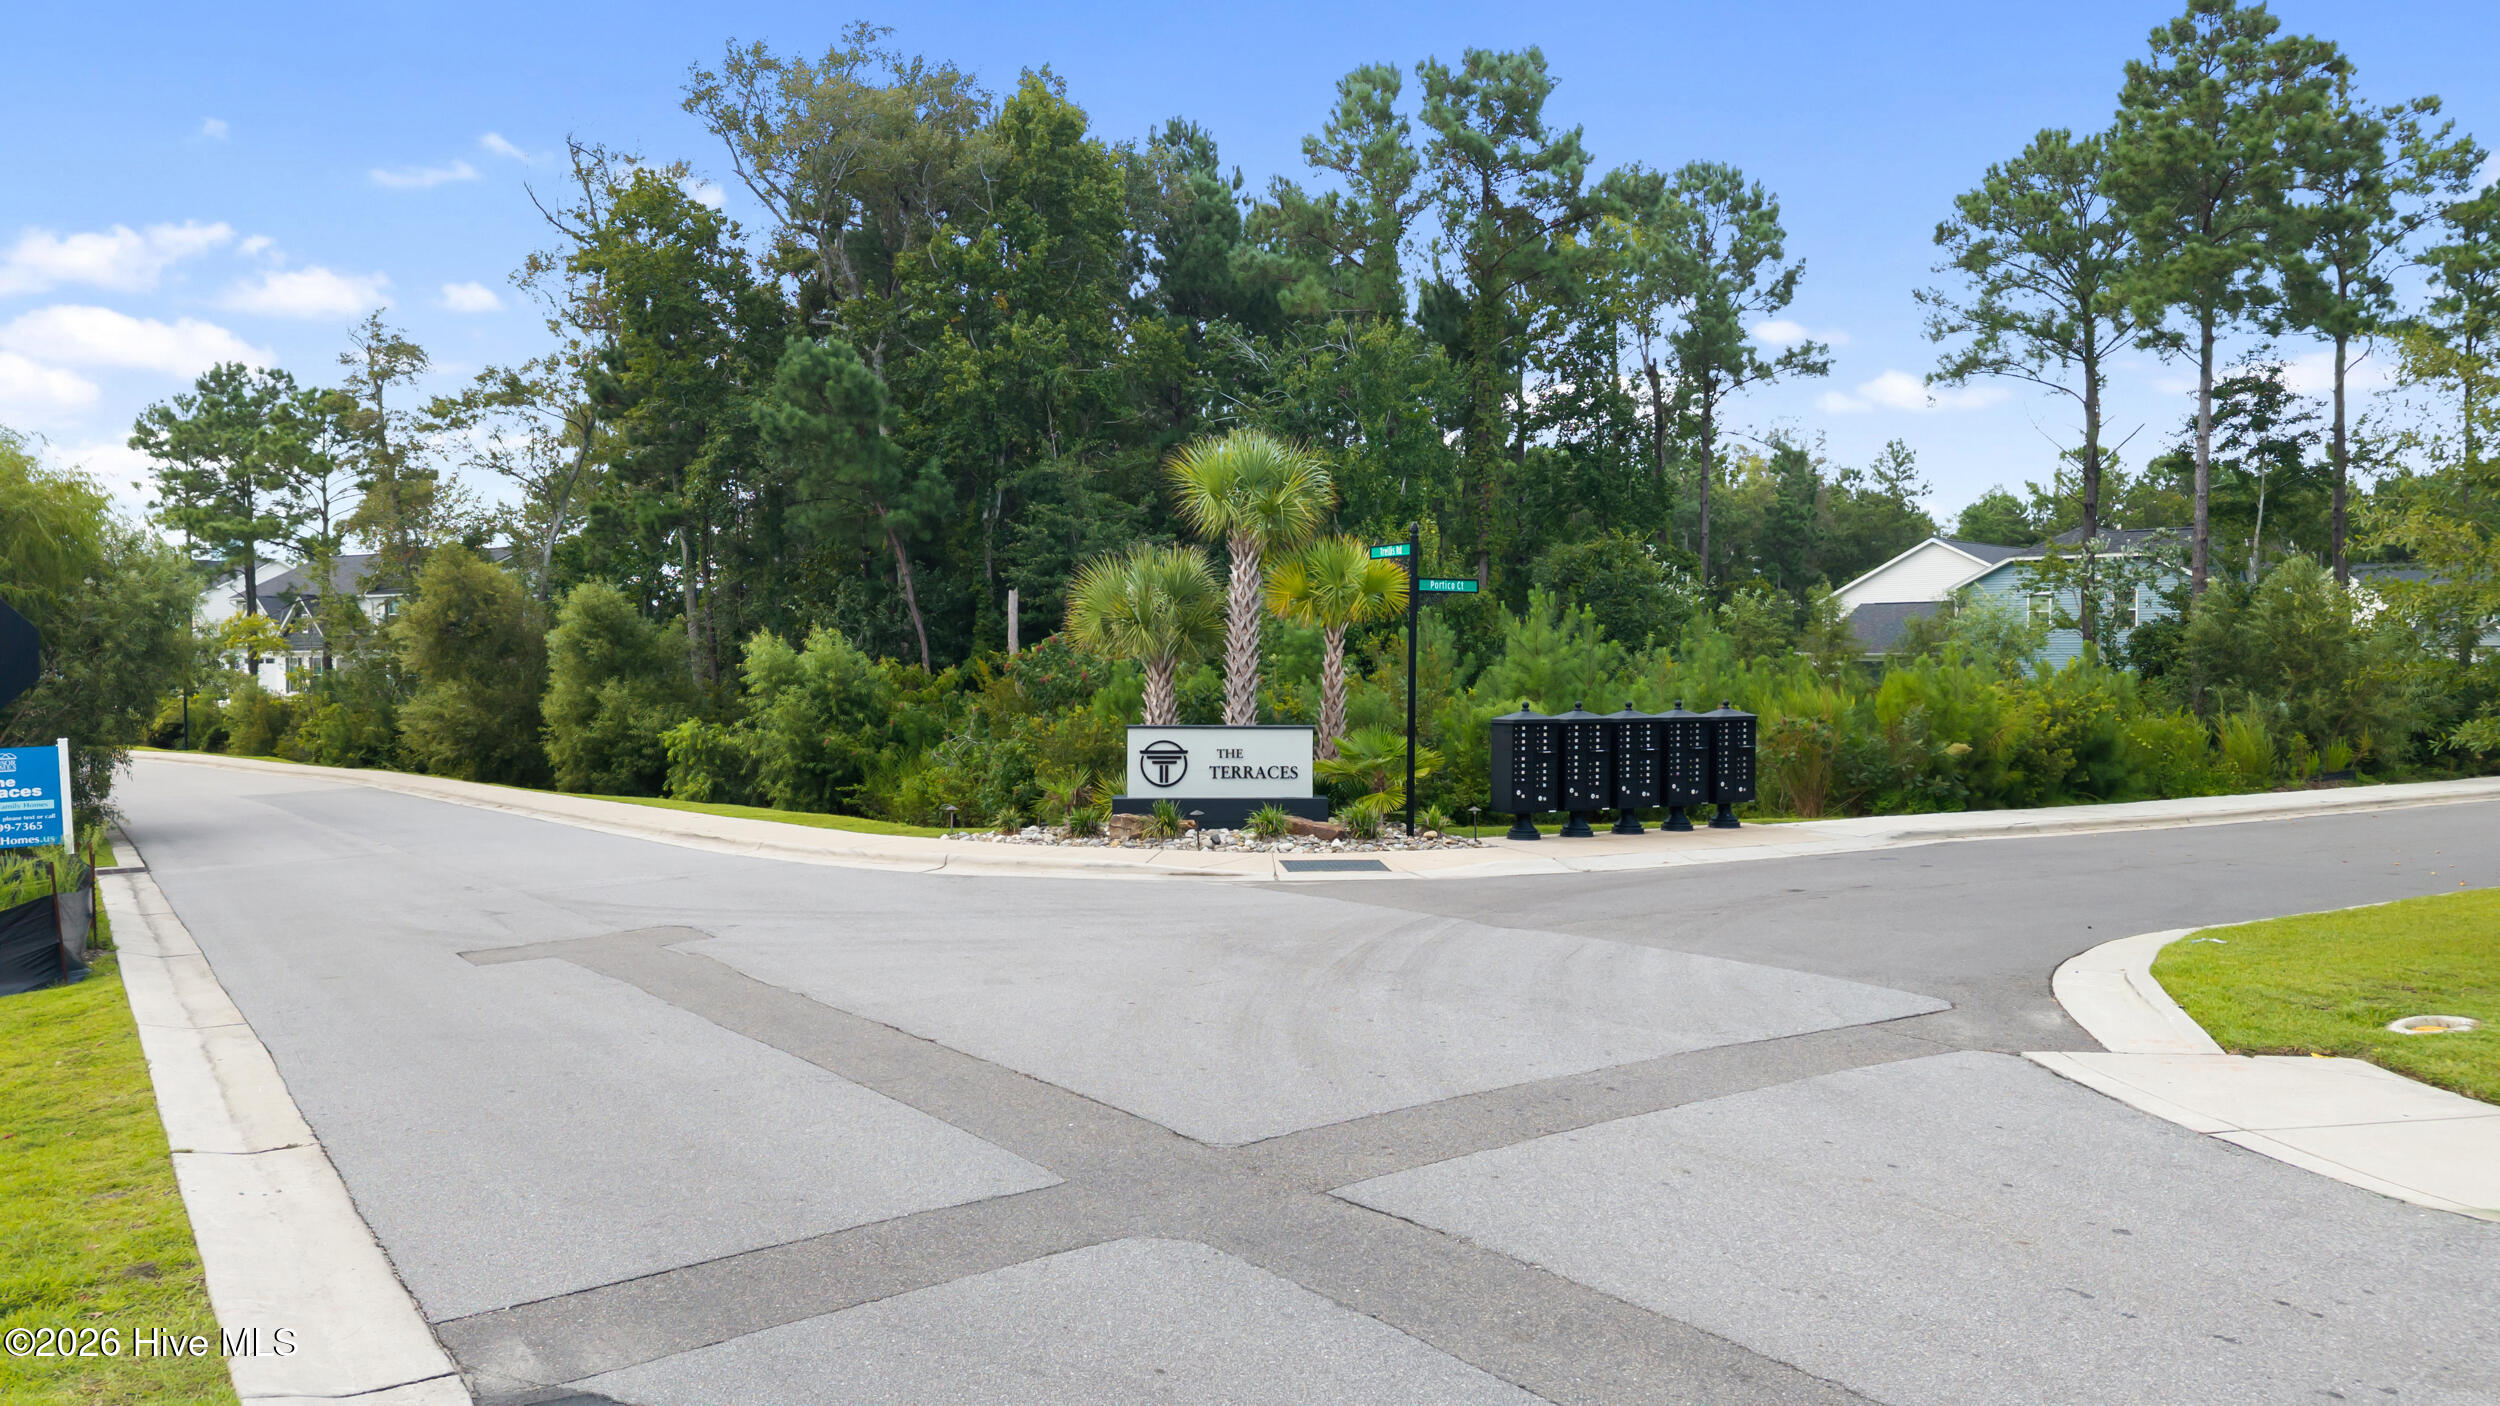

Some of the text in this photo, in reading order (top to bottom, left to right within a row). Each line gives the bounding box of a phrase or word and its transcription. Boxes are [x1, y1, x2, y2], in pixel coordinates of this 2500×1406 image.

[1430, 580, 1464, 590] Portico Ct
[1216, 748, 1244, 759] THE
[1209, 765, 1299, 780] TERRACES
